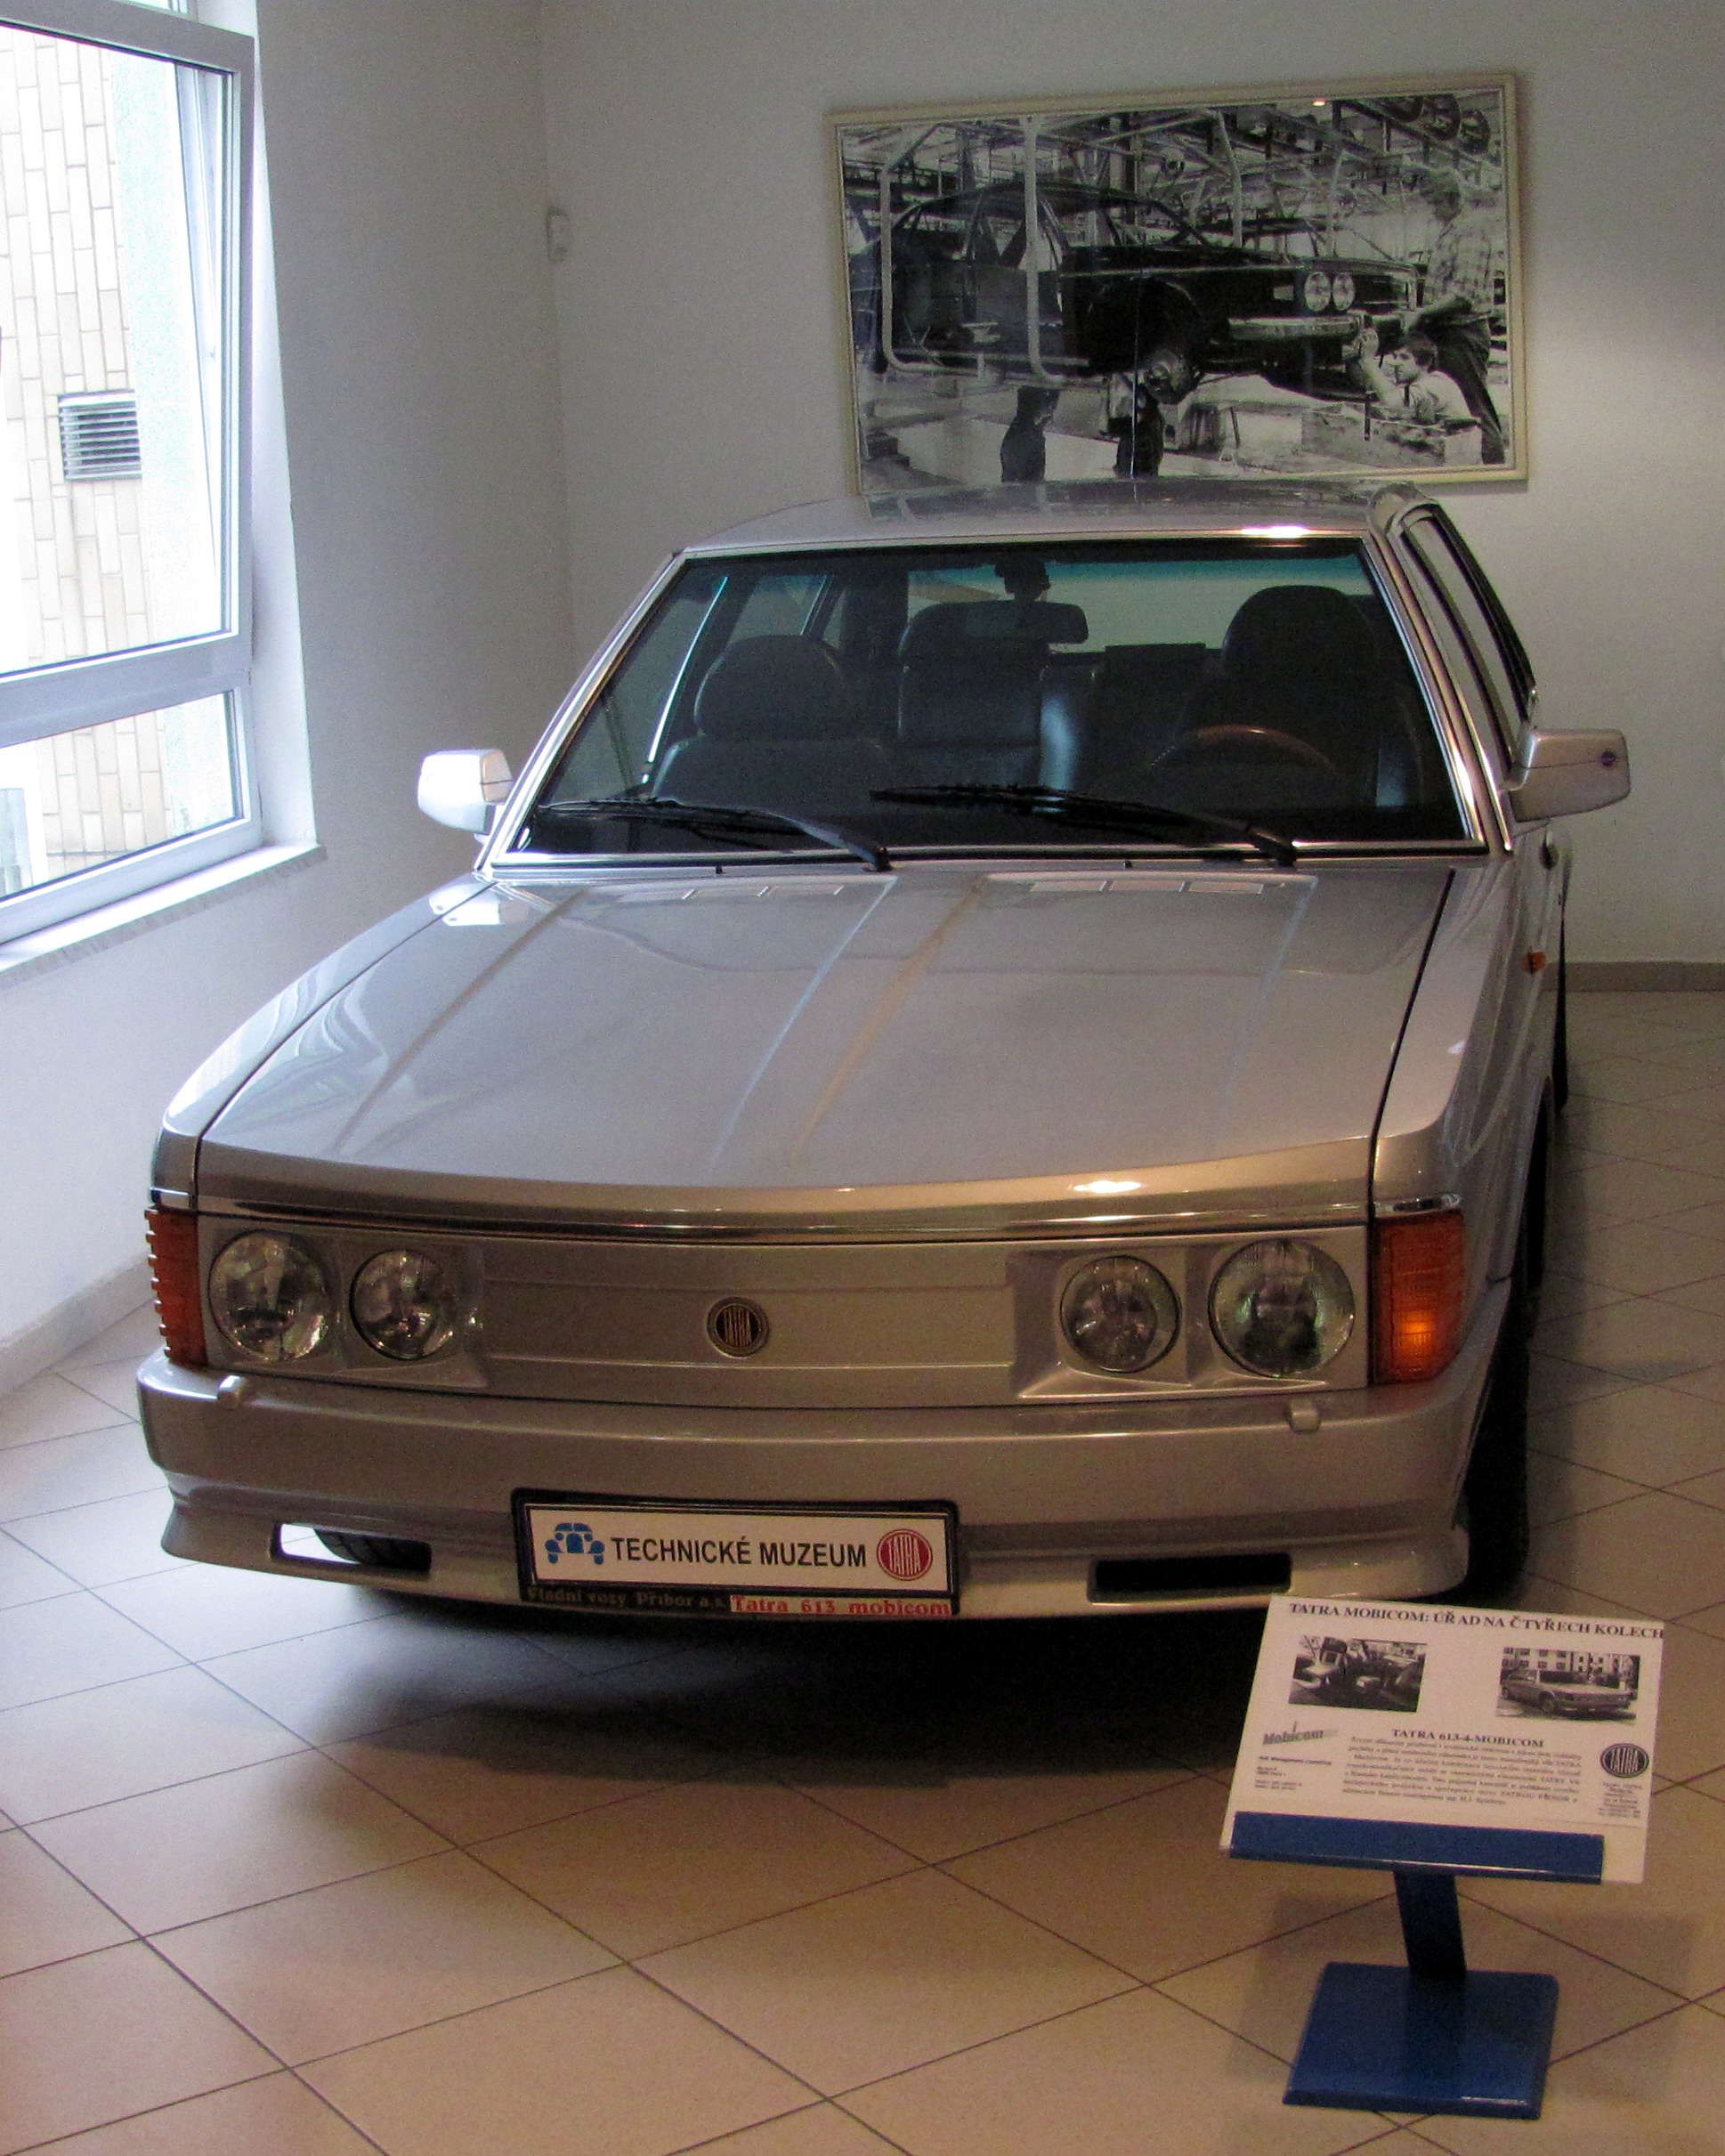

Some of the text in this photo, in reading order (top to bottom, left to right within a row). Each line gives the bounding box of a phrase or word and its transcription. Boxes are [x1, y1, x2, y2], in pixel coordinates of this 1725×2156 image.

[611, 1536, 867, 1568] TECHNICKÉ MUZEUM
[731, 1594, 952, 1618] Tatra 613 mobicom
[1290, 1602, 1340, 1617] TATRA
[1343, 1606, 1429, 1623] MOBICOM:
[1483, 1616, 1505, 1628] NA
[1594, 1623, 1664, 1640] KOLECH
[1391, 1728, 1436, 1740] TATRA
